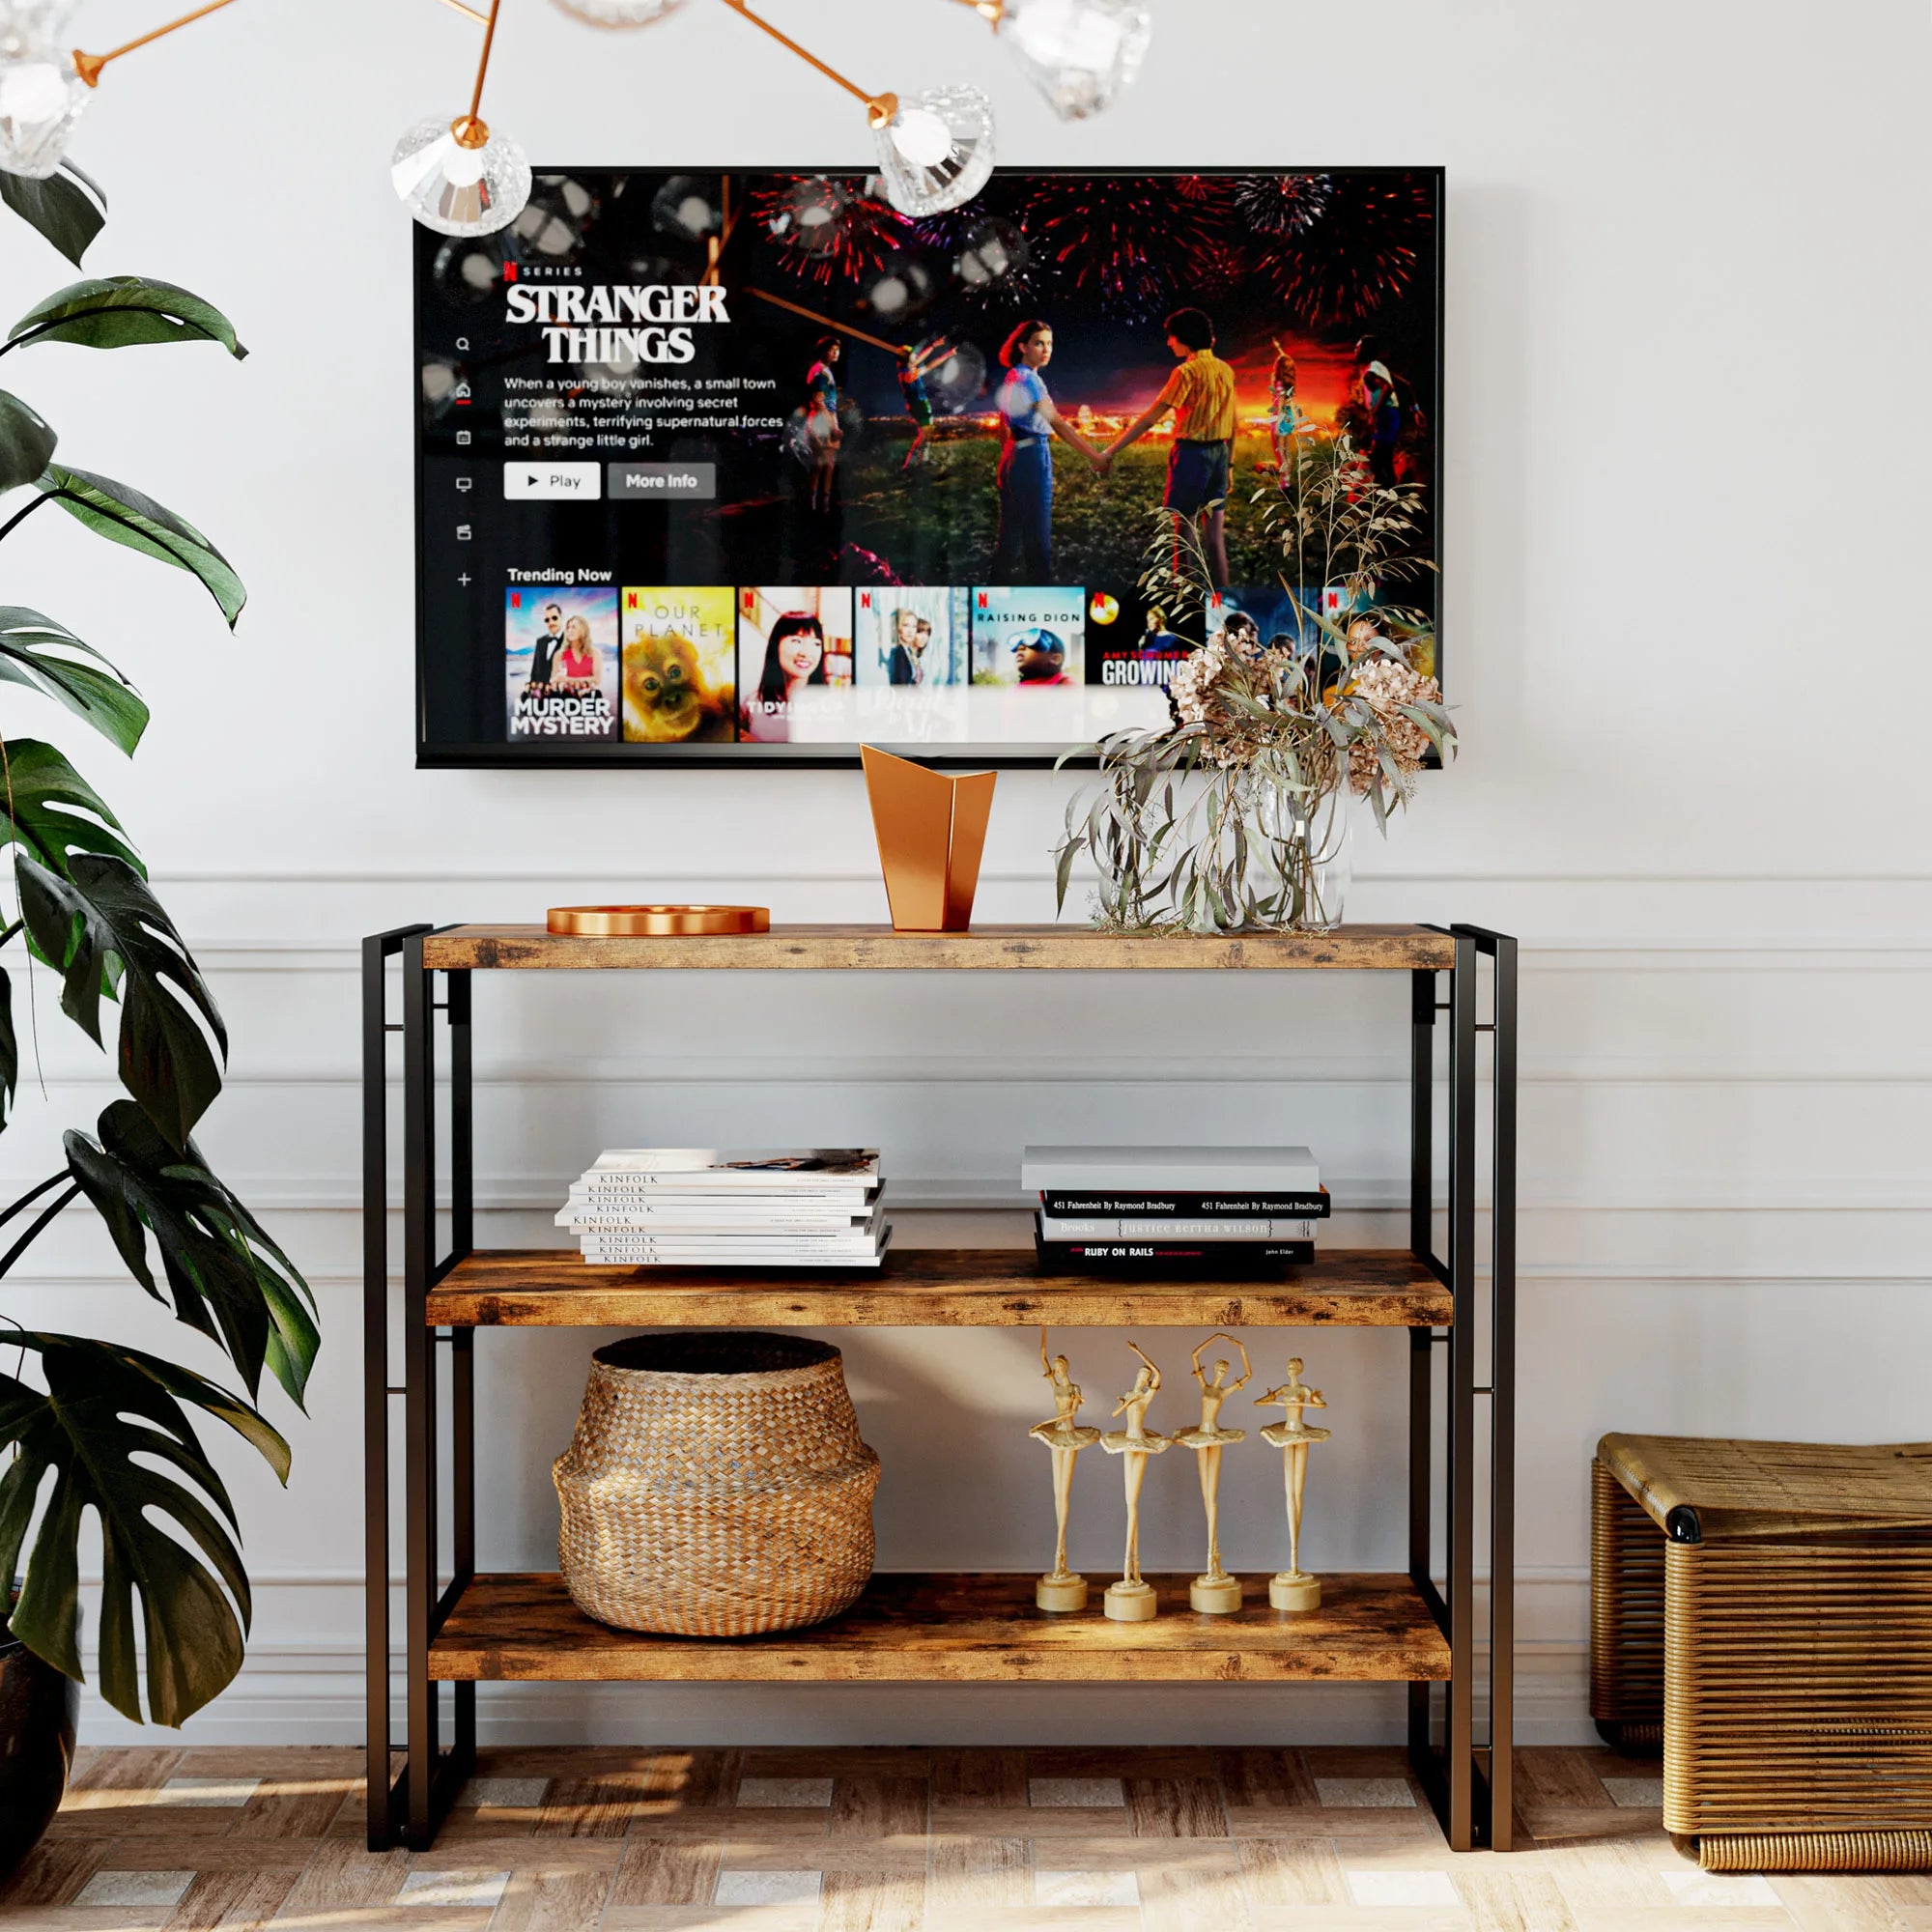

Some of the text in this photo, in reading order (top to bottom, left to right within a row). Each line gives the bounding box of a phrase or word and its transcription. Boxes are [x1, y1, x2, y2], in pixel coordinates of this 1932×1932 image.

[523, 267, 582, 277] SERIES
[505, 284, 731, 324] STRANGER
[542, 327, 696, 363] THINGS
[504, 377, 776, 393] When a young boy vanishes, a small town
[504, 395, 739, 412] uncovers a mystery involving secret
[503, 414, 783, 431] experiments, terrifying supernatural forces
[503, 434, 654, 450] and a strange little girl.
[550, 474, 582, 489] Play
[626, 474, 697, 488] More Info
[507, 568, 612, 584] Trending Now
[654, 606, 700, 619] OUR
[978, 613, 1080, 622] RAISING DION
[635, 623, 724, 638] PLANET
[1103, 651, 1127, 660] AMY
[514, 697, 611, 717] MURDER
[510, 716, 614, 735] MYSTERY
[600, 1175, 658, 1183] KINFOLK
[1067, 1201, 1102, 1209] Fahrenheit
[1103, 1202, 1112, 1211] By
[1114, 1201, 1145, 1211] Raymond
[1146, 1201, 1176, 1211] Bradbury
[1215, 1201, 1250, 1209] Fahrenheit
[1252, 1202, 1261, 1211] By
[1262, 1201, 1293, 1211] Raymond
[1294, 1202, 1323, 1212] Bradbury
[574, 1216, 632, 1225] KINFOLK
[1061, 1222, 1095, 1233] Brooks
[1084, 1247, 1108, 1257] RUBY
[1112, 1247, 1125, 1257] ON
[1129, 1247, 1153, 1257] RAILS
